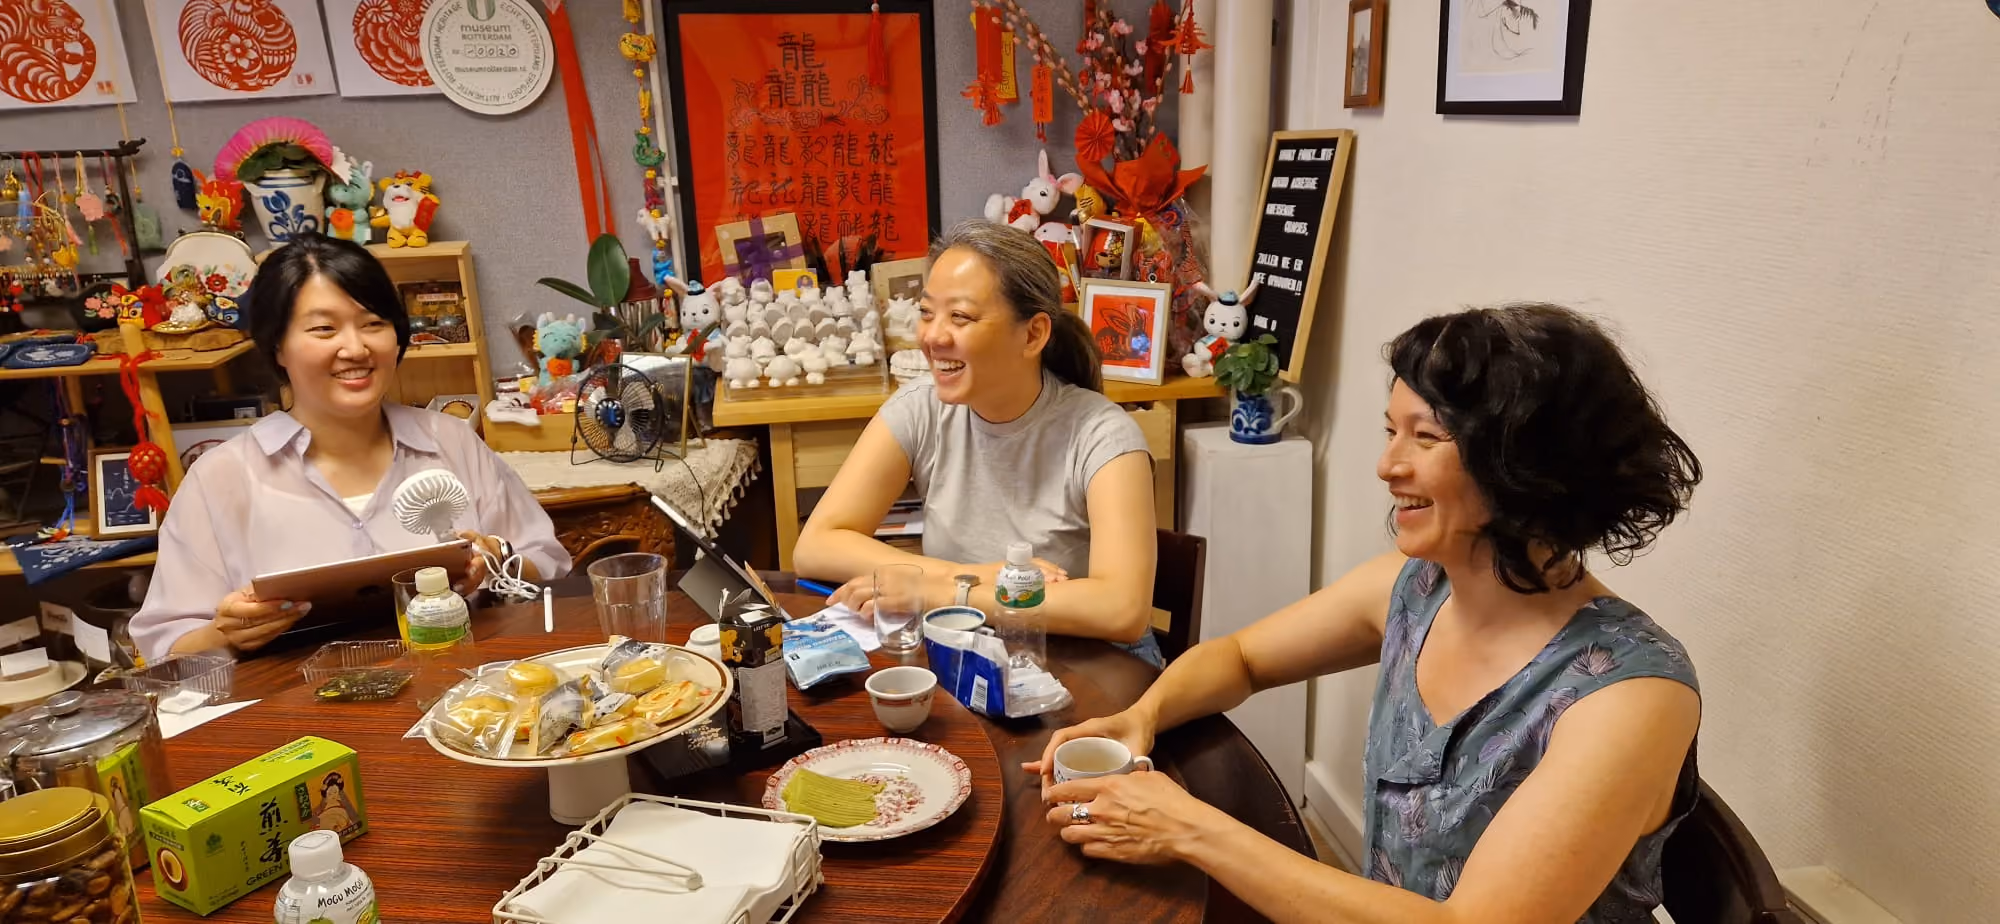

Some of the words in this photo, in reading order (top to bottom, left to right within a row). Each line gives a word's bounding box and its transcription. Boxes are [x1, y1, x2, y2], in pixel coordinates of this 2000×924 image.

[461, 24, 511, 32] museum
[461, 33, 512, 41] ROTTERDAM
[778, 32, 824, 71] 龍
[246, 865, 284, 887] GREEN
